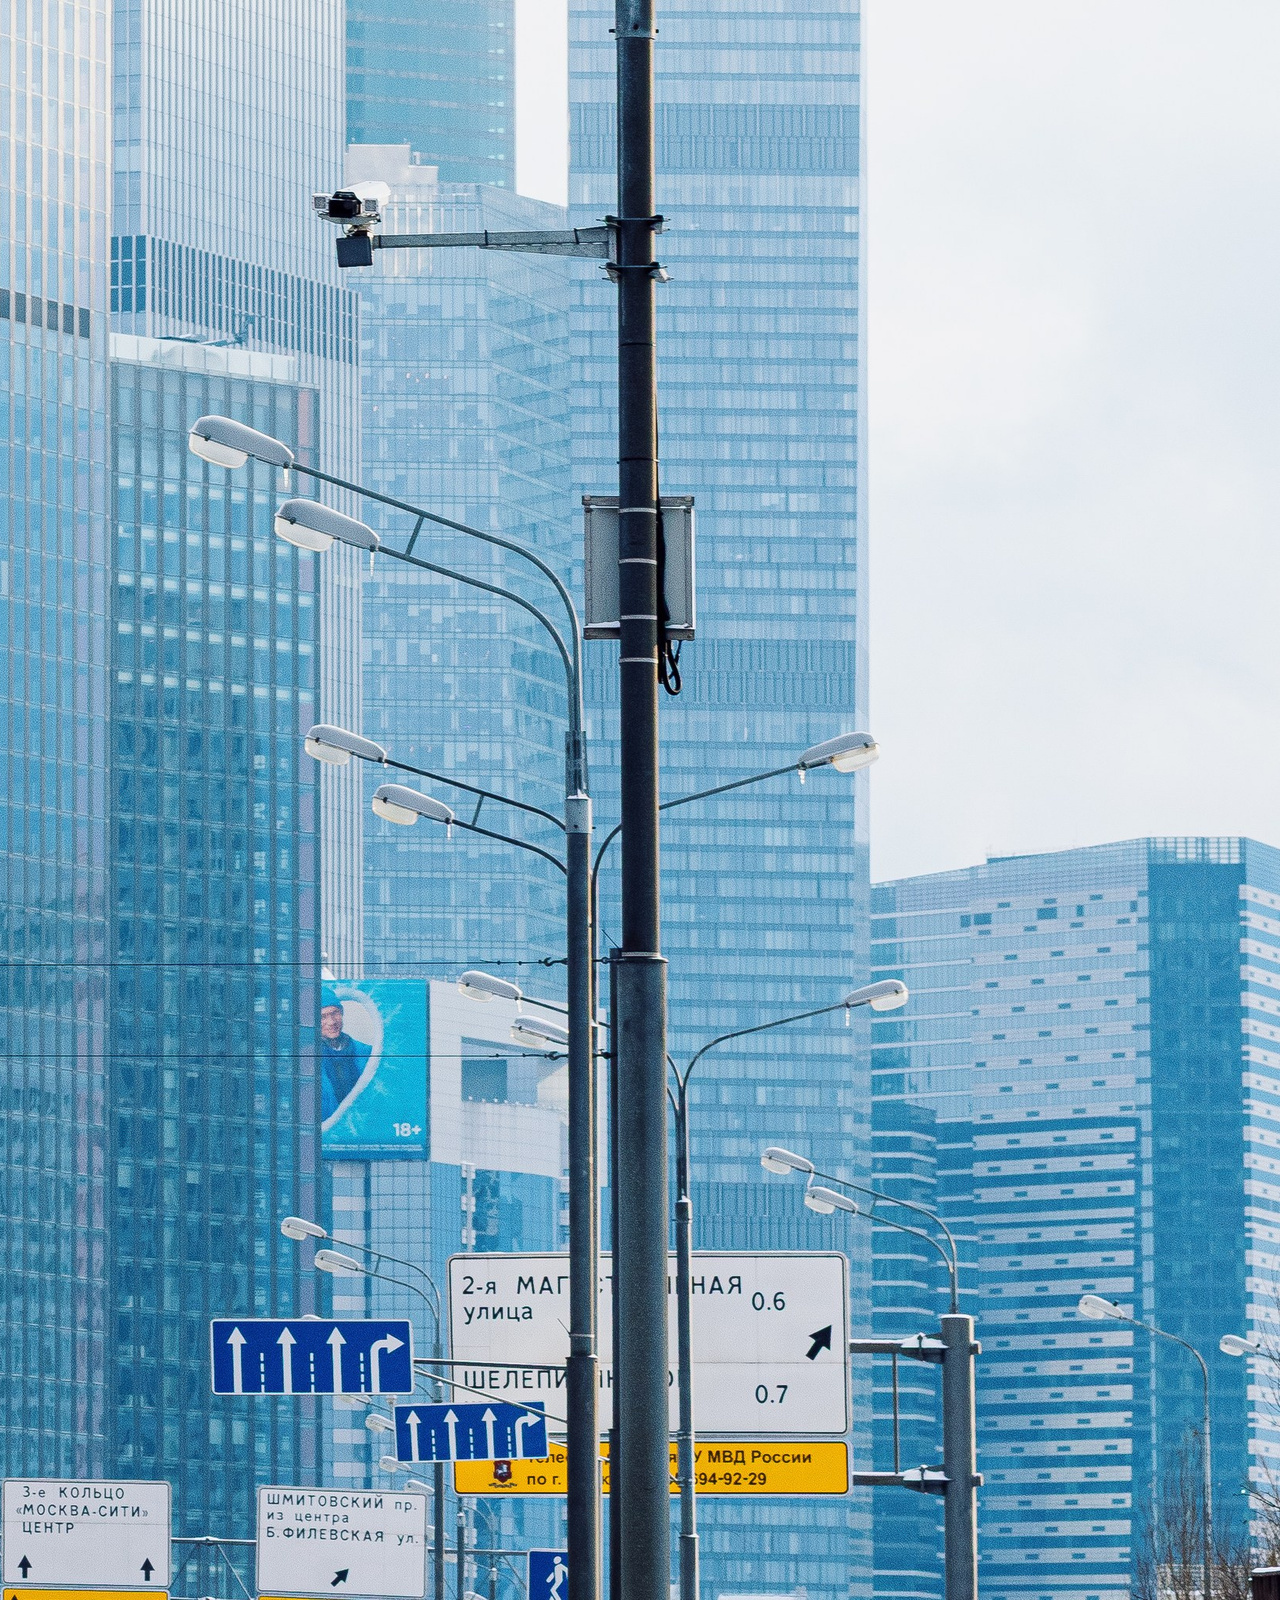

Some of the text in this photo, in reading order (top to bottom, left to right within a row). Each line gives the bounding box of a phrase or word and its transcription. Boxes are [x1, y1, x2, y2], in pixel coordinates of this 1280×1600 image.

[392, 1122, 422, 1137] 18+
[462, 1276, 496, 1295] 2-я
[751, 1291, 786, 1311] 0.6
[463, 1306, 533, 1325] улица
[755, 1384, 788, 1404] 0.7
[708, 1450, 746, 1465] МВД
[751, 1450, 812, 1464] России
[527, 1475, 547, 1485] по
[552, 1475, 561, 1485] г.
[23, 1485, 125, 1501] 3-е КОЛЬЦО
[16, 1503, 149, 1518] «МОСКВА-СИТИ»
[267, 1493, 418, 1513] ШМИТОВСКИЙ пр.
[267, 1511, 350, 1526] из центра
[22, 1521, 74, 1535] ЦЕНТР
[397, 1533, 419, 1546] ул.
